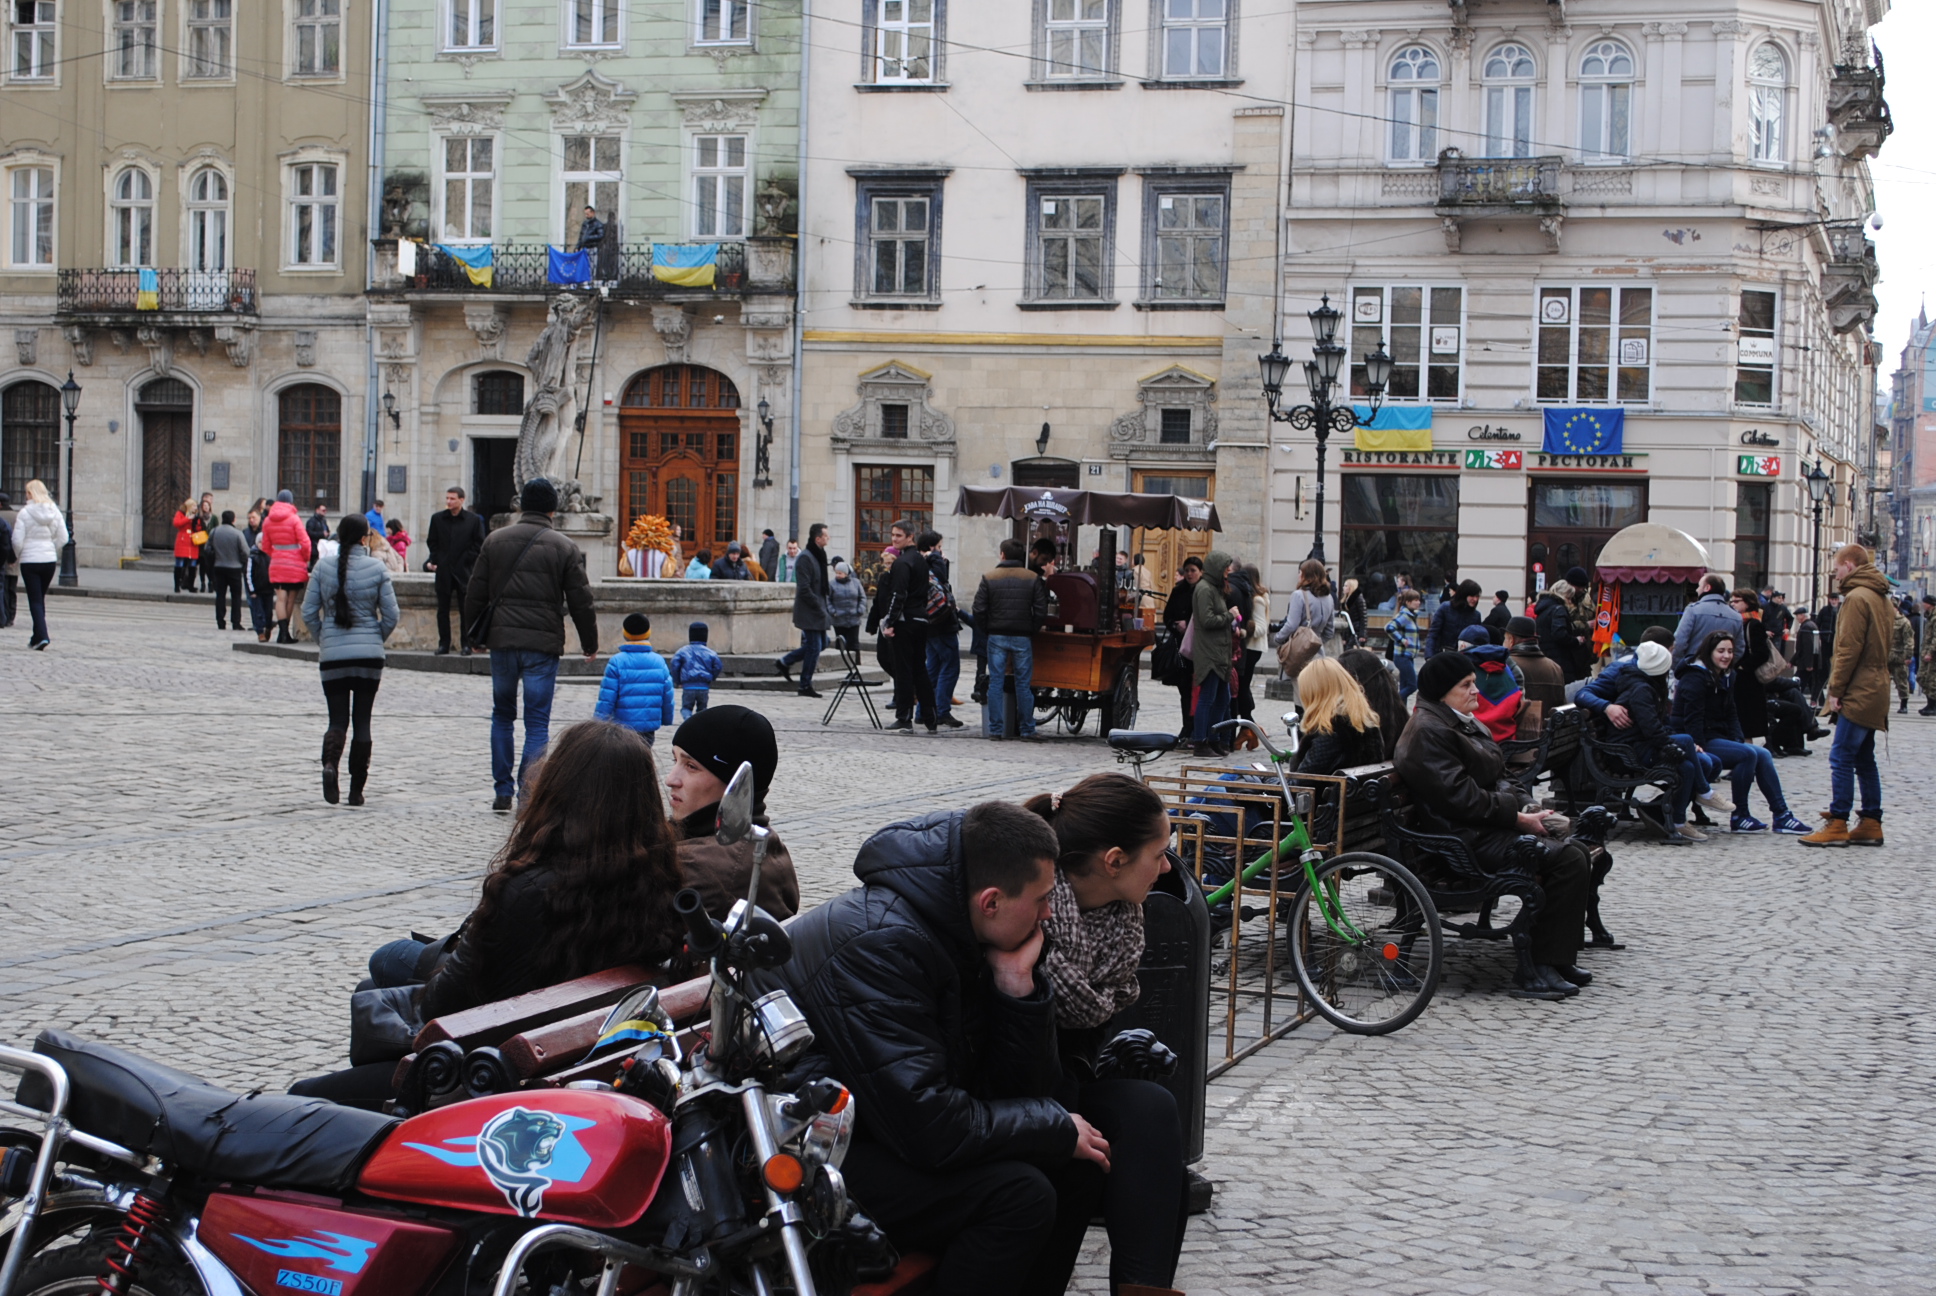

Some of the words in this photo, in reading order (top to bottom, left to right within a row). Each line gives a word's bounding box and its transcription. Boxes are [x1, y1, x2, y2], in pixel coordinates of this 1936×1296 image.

[1740, 350, 1773, 358] COMMUNA
[206, 431, 215, 441] 19
[1468, 425, 1521, 441] Celentano
[1344, 452, 1457, 464] RISTORANTE
[1538, 455, 1633, 467] РЕСТОРАН
[1090, 466, 1100, 475] 21
[278, 1270, 341, 1294] ZS50F
